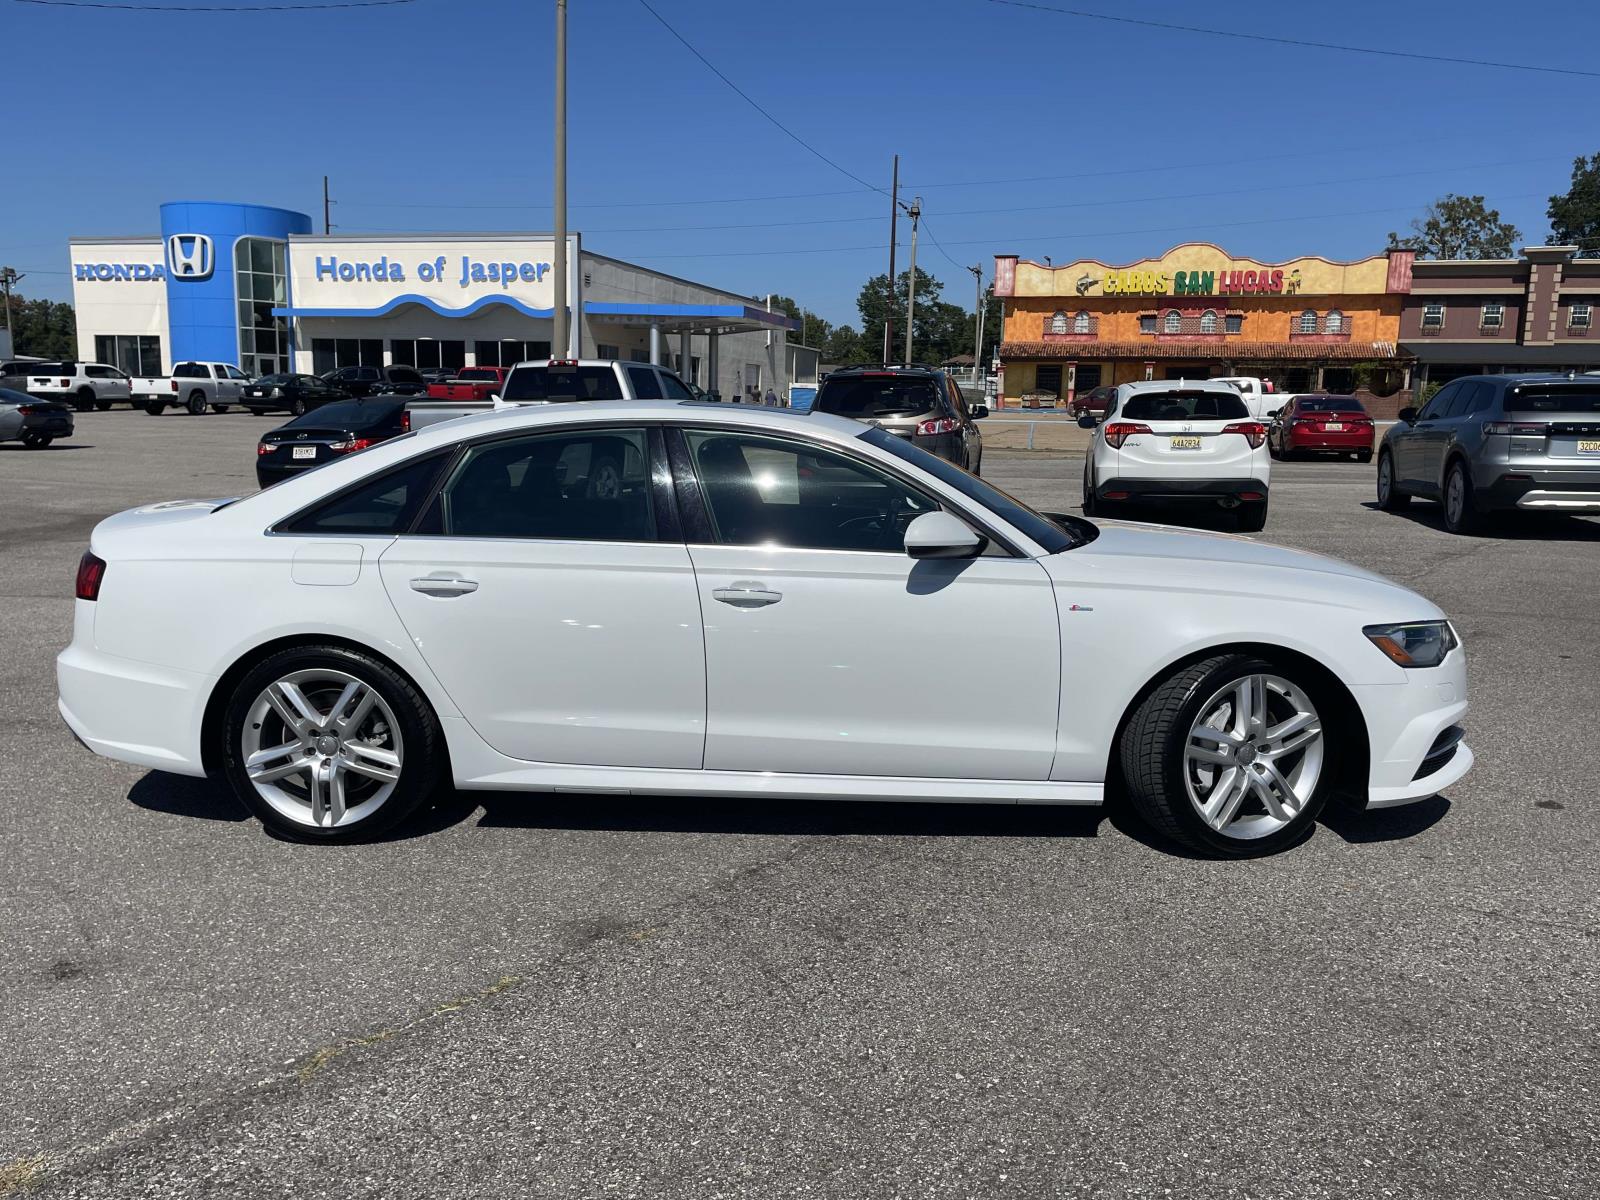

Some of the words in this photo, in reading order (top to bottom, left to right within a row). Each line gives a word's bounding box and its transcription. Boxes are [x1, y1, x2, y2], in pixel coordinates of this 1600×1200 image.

[74, 263, 166, 281] HONDA
[315, 256, 405, 282] Honda
[417, 256, 446, 282] of
[459, 256, 551, 289] Jasper
[1102, 270, 1169, 295] CABOS
[1173, 270, 1215, 295] SAN
[1219, 269, 1284, 294] LUCAS
